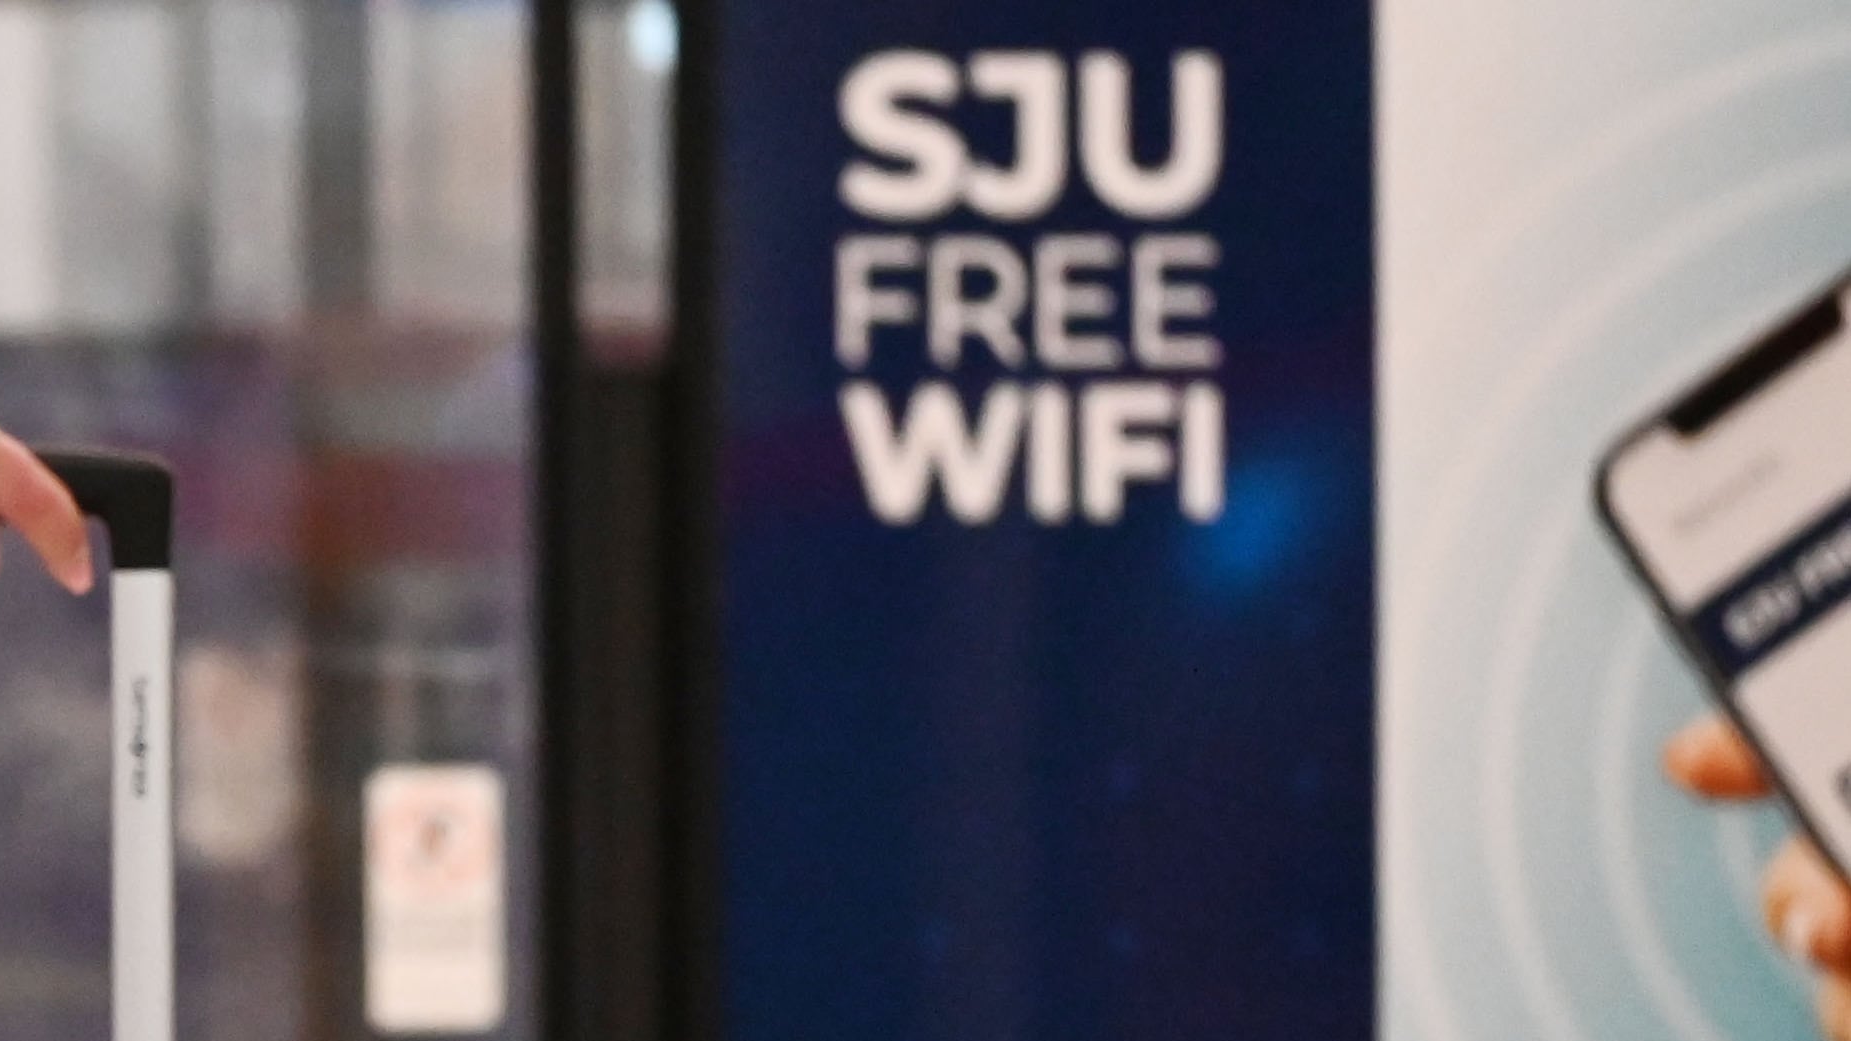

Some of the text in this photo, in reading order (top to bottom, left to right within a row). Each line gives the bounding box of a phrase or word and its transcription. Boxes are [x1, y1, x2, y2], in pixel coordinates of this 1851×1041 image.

[839, 49, 1225, 220] SJU
[835, 233, 1221, 369] FREE
[840, 381, 1225, 524] WIFI
